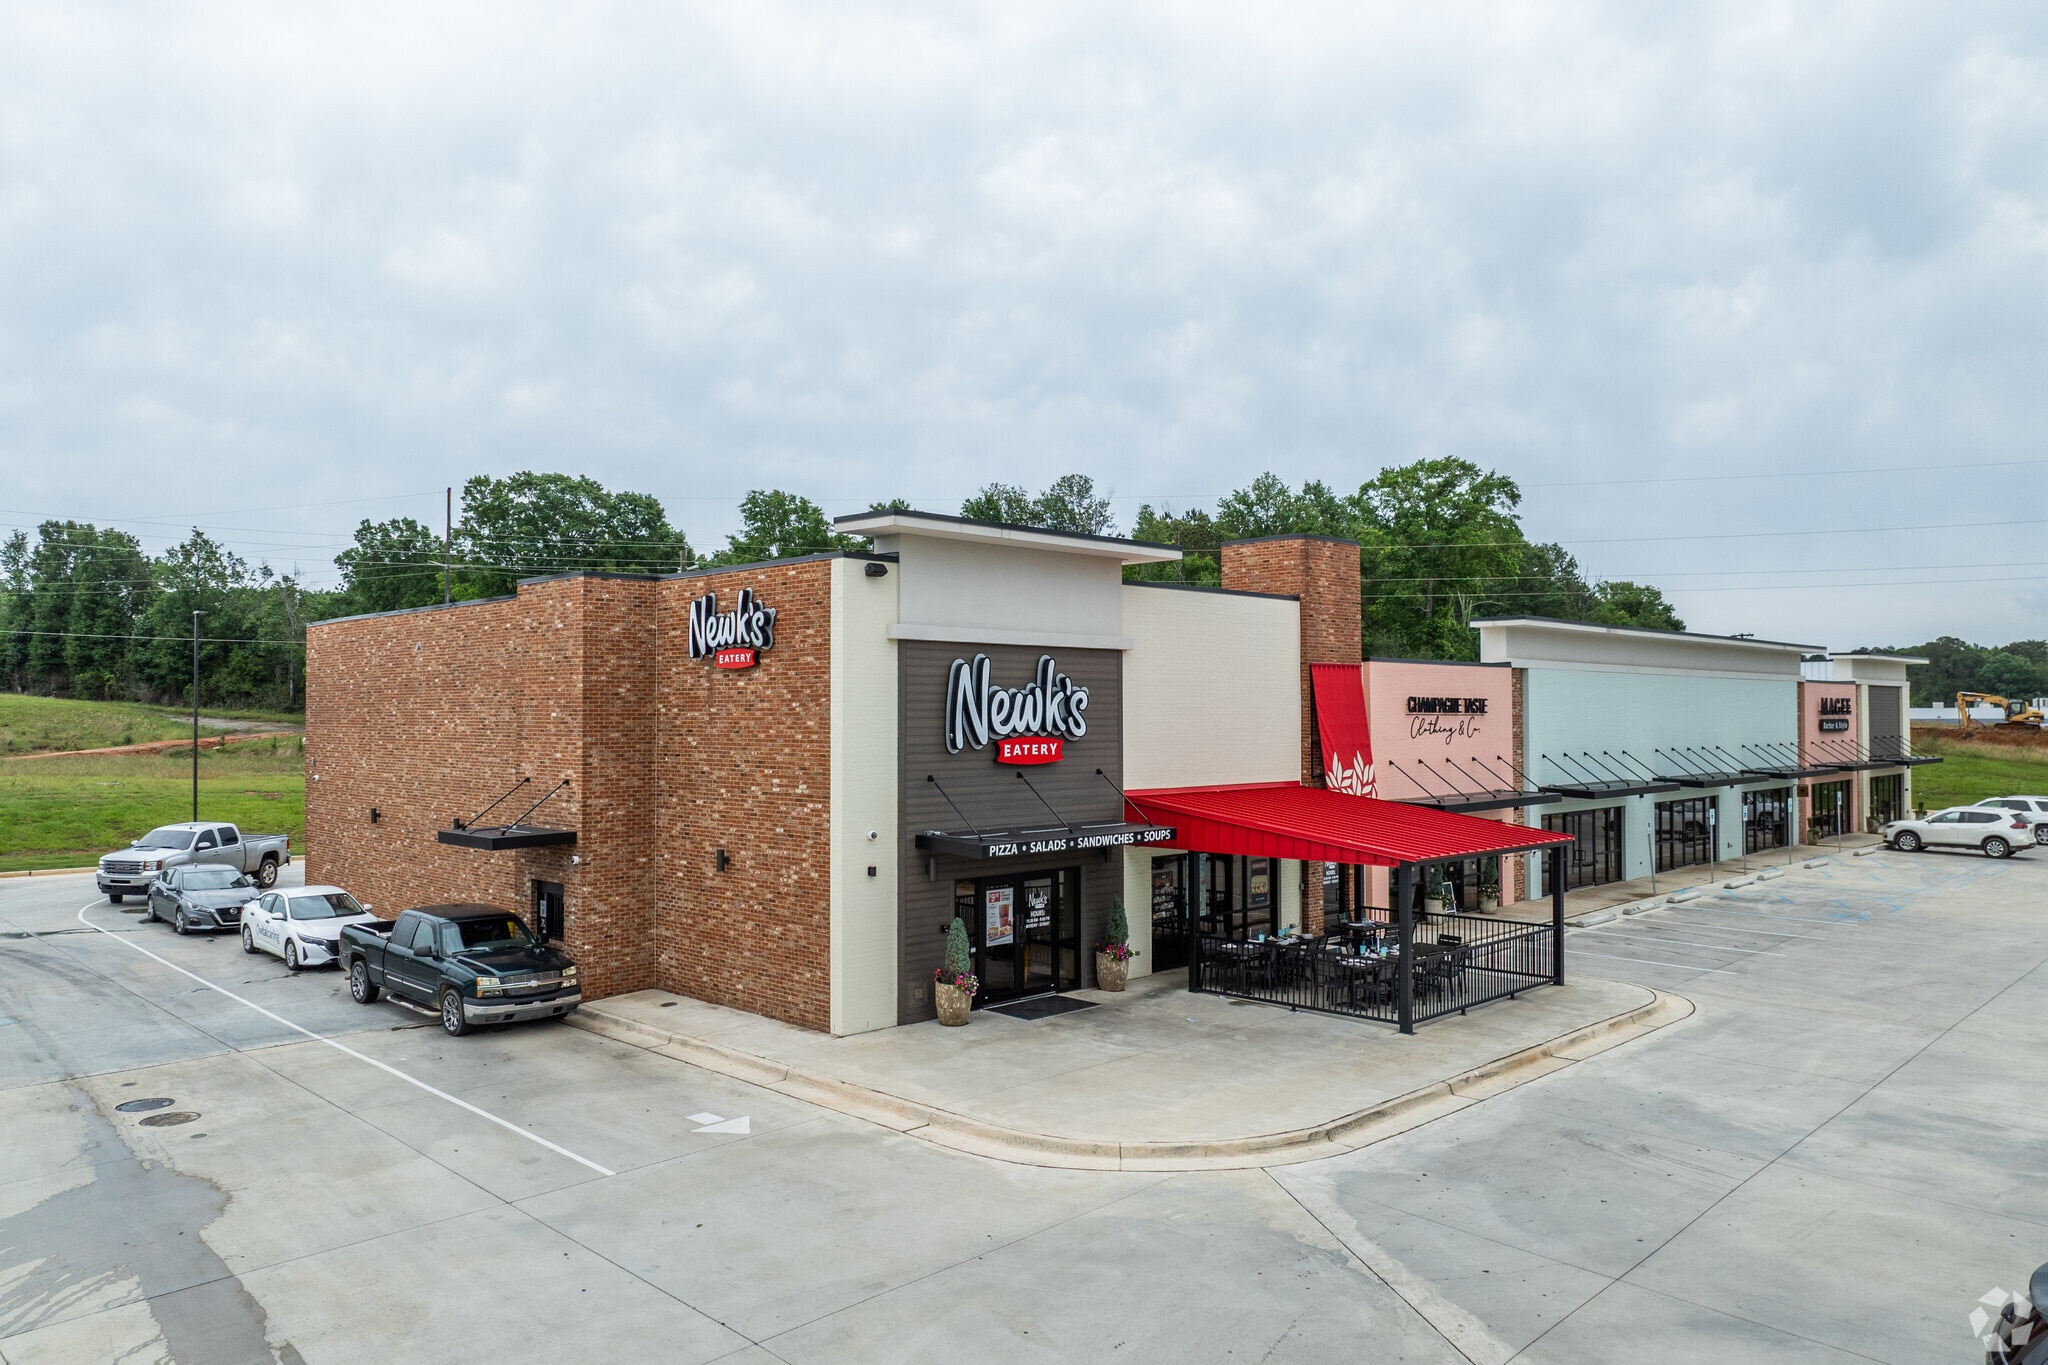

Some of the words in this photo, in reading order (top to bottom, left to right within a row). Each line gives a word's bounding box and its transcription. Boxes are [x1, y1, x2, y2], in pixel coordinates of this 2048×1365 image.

[689, 588, 770, 660] Newk's
[719, 653, 752, 665] EATERY
[948, 654, 1088, 753] Newk's
[1407, 696, 1462, 713] CHAMPAGNE
[1463, 697, 1488, 713] TASTE
[1820, 697, 1852, 715] MAGEE
[1410, 715, 1457, 745] Clothing
[1458, 720, 1465, 736] &
[1004, 743, 1057, 757] EATERY
[989, 843, 1018, 857] PIZZA
[1030, 839, 1066, 853] SALADS
[1077, 833, 1134, 849] SANDWICHES
[1144, 829, 1171, 842] SOUPS
